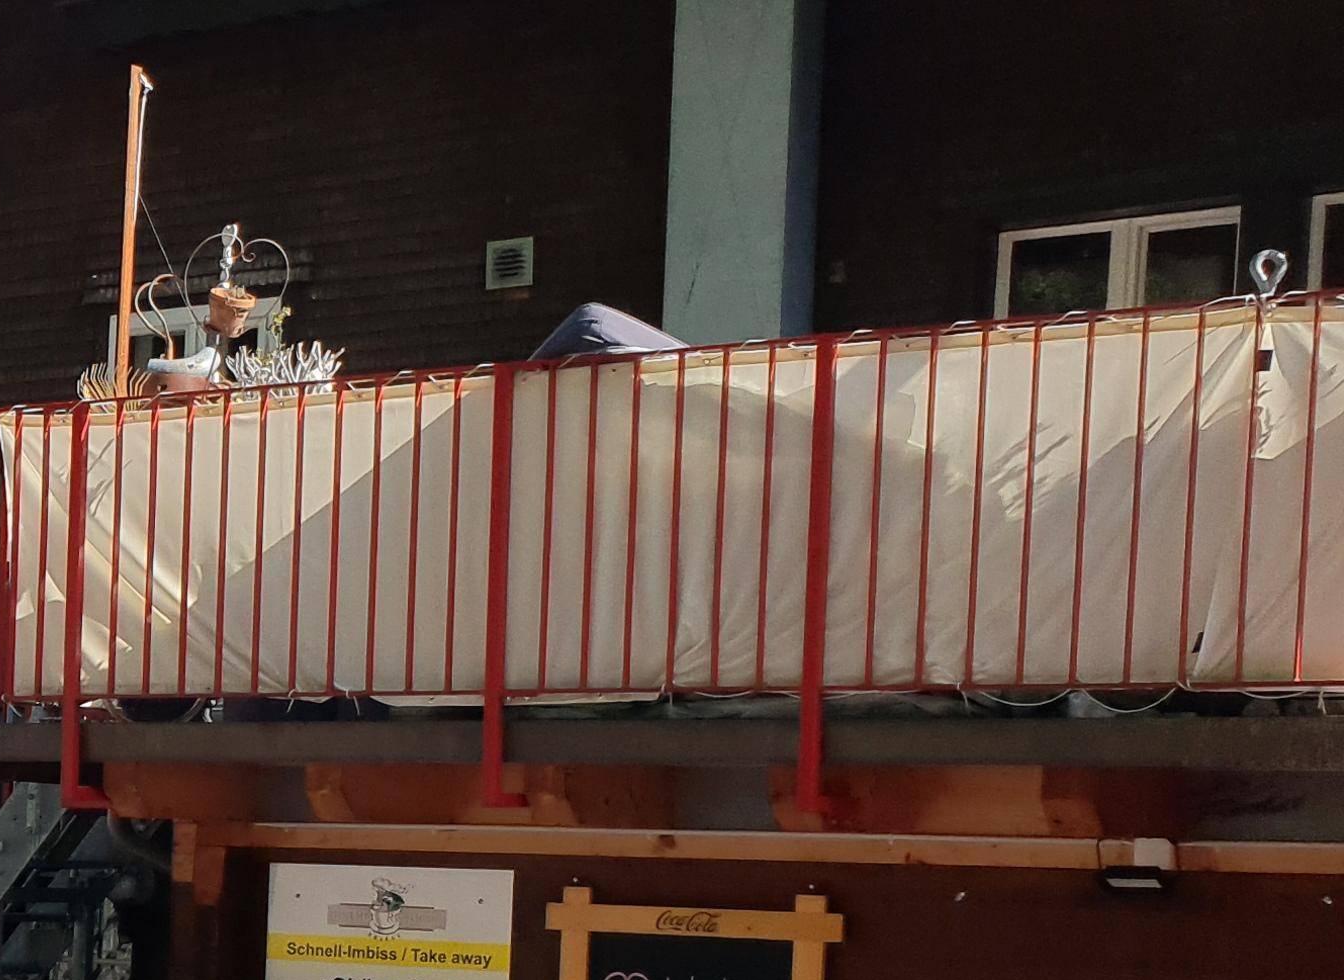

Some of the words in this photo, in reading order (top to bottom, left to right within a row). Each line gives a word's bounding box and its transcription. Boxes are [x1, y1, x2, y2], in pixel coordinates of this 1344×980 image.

[287, 942, 397, 962] Schnell-Imbiss
[412, 949, 447, 965] Take
[451, 954, 492, 970] away
